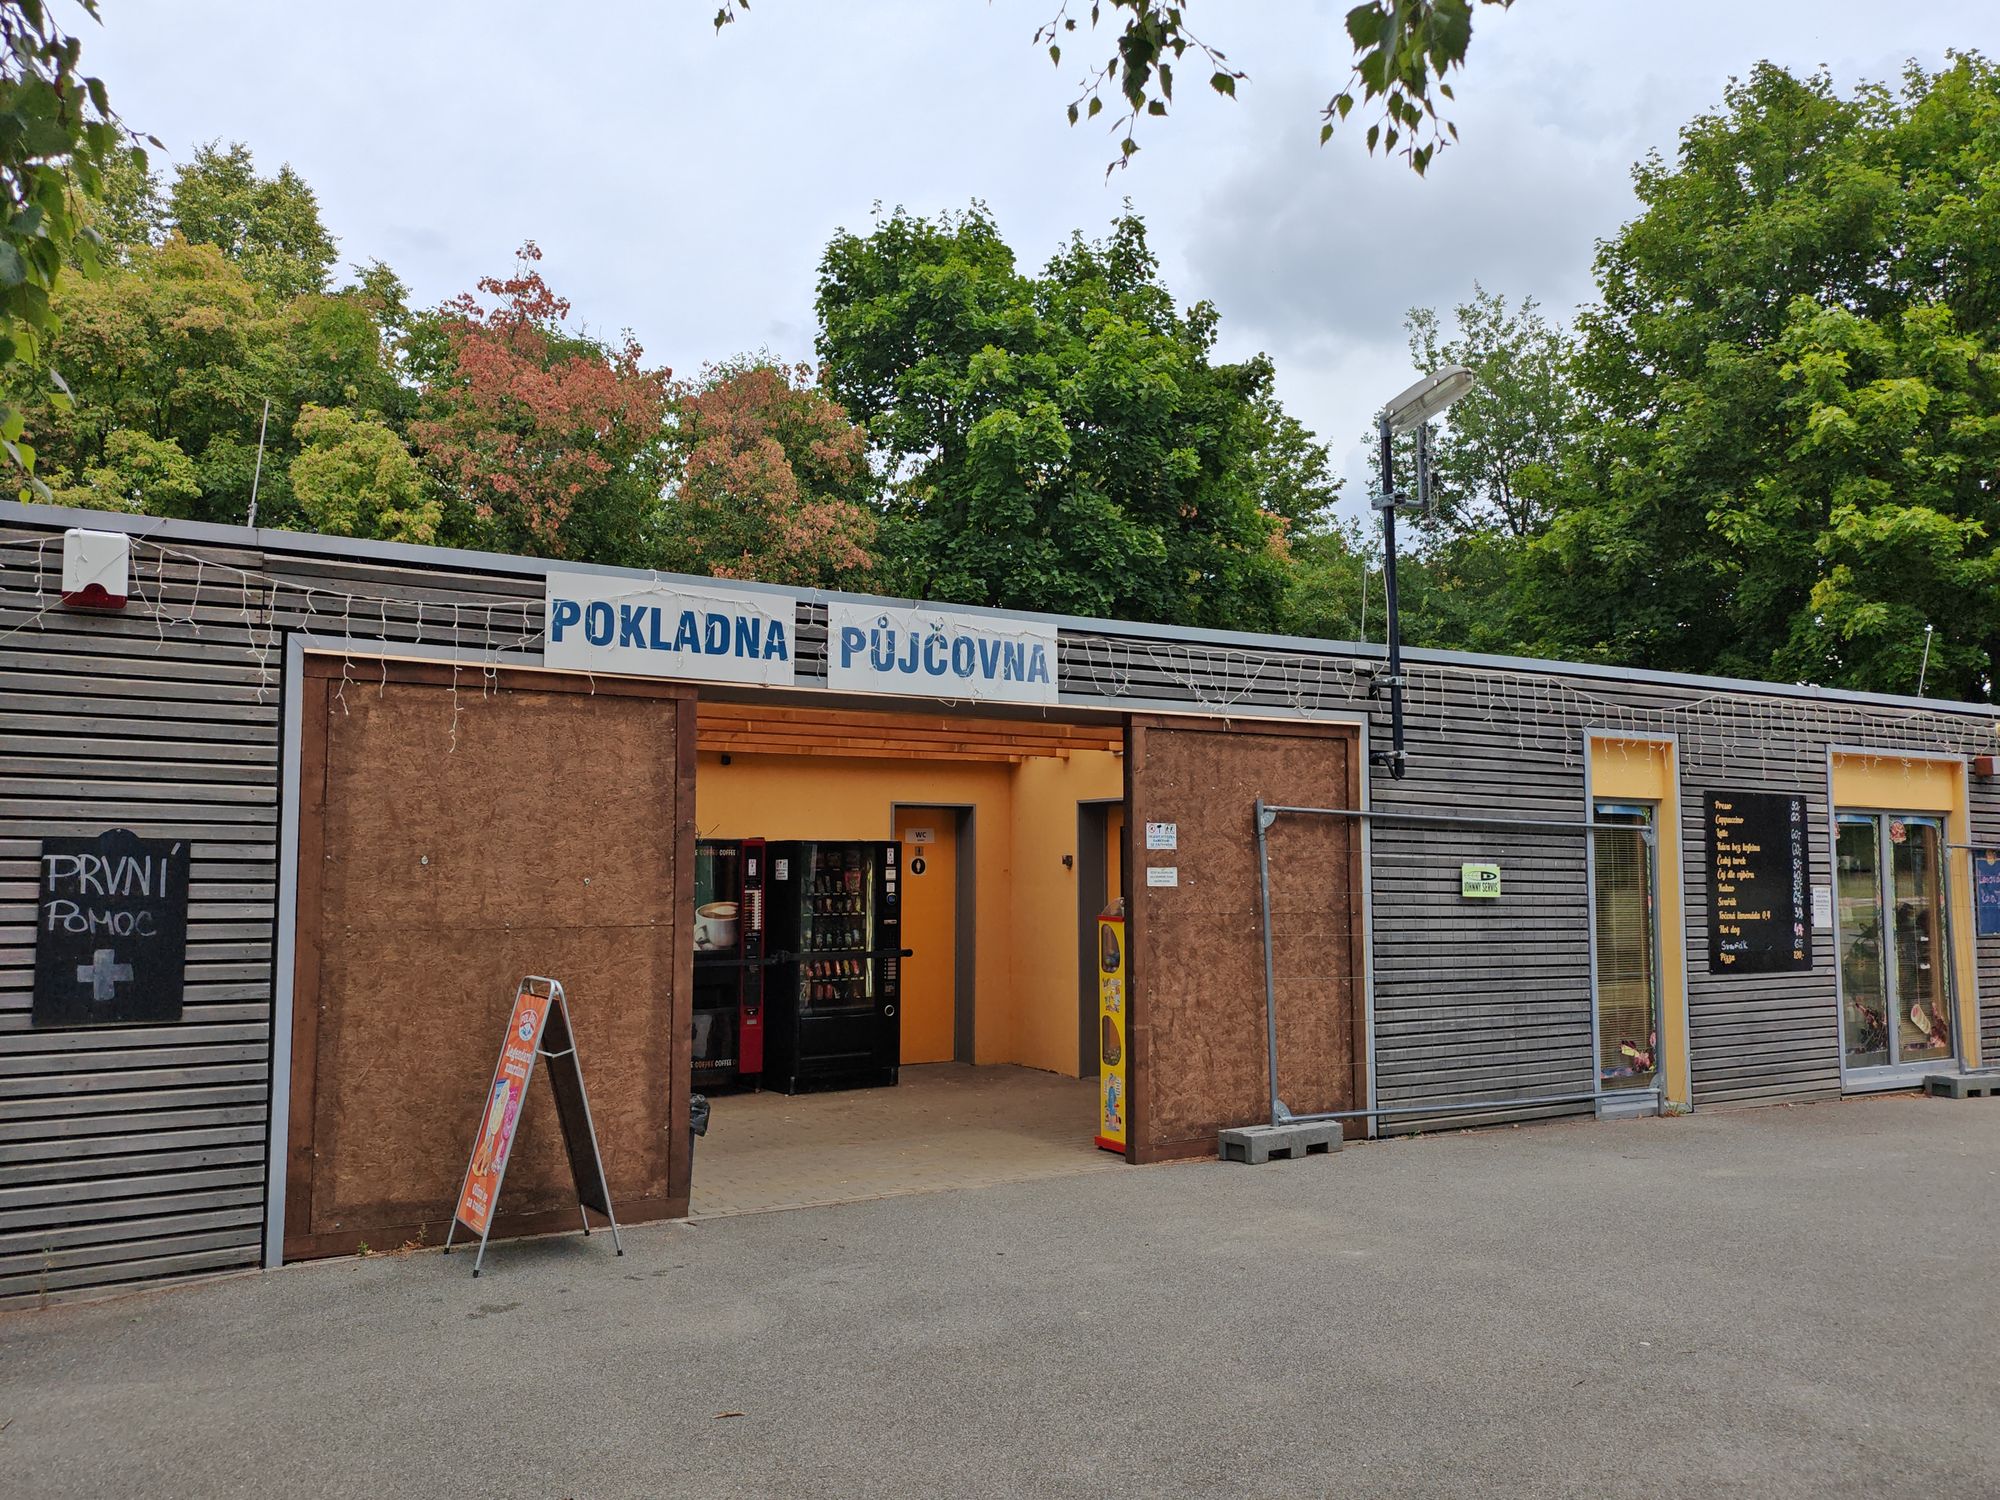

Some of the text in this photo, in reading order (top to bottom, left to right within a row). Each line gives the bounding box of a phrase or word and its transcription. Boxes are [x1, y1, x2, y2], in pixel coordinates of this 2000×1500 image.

[551, 598, 789, 662] POKLADNA
[840, 615, 1050, 684] PŮJČOVNA
[42, 842, 181, 898] PRVNÍ
[43, 899, 157, 937] POMOC
[1730, 925, 1740, 936] dog
[1720, 952, 1735, 964] Pizza
